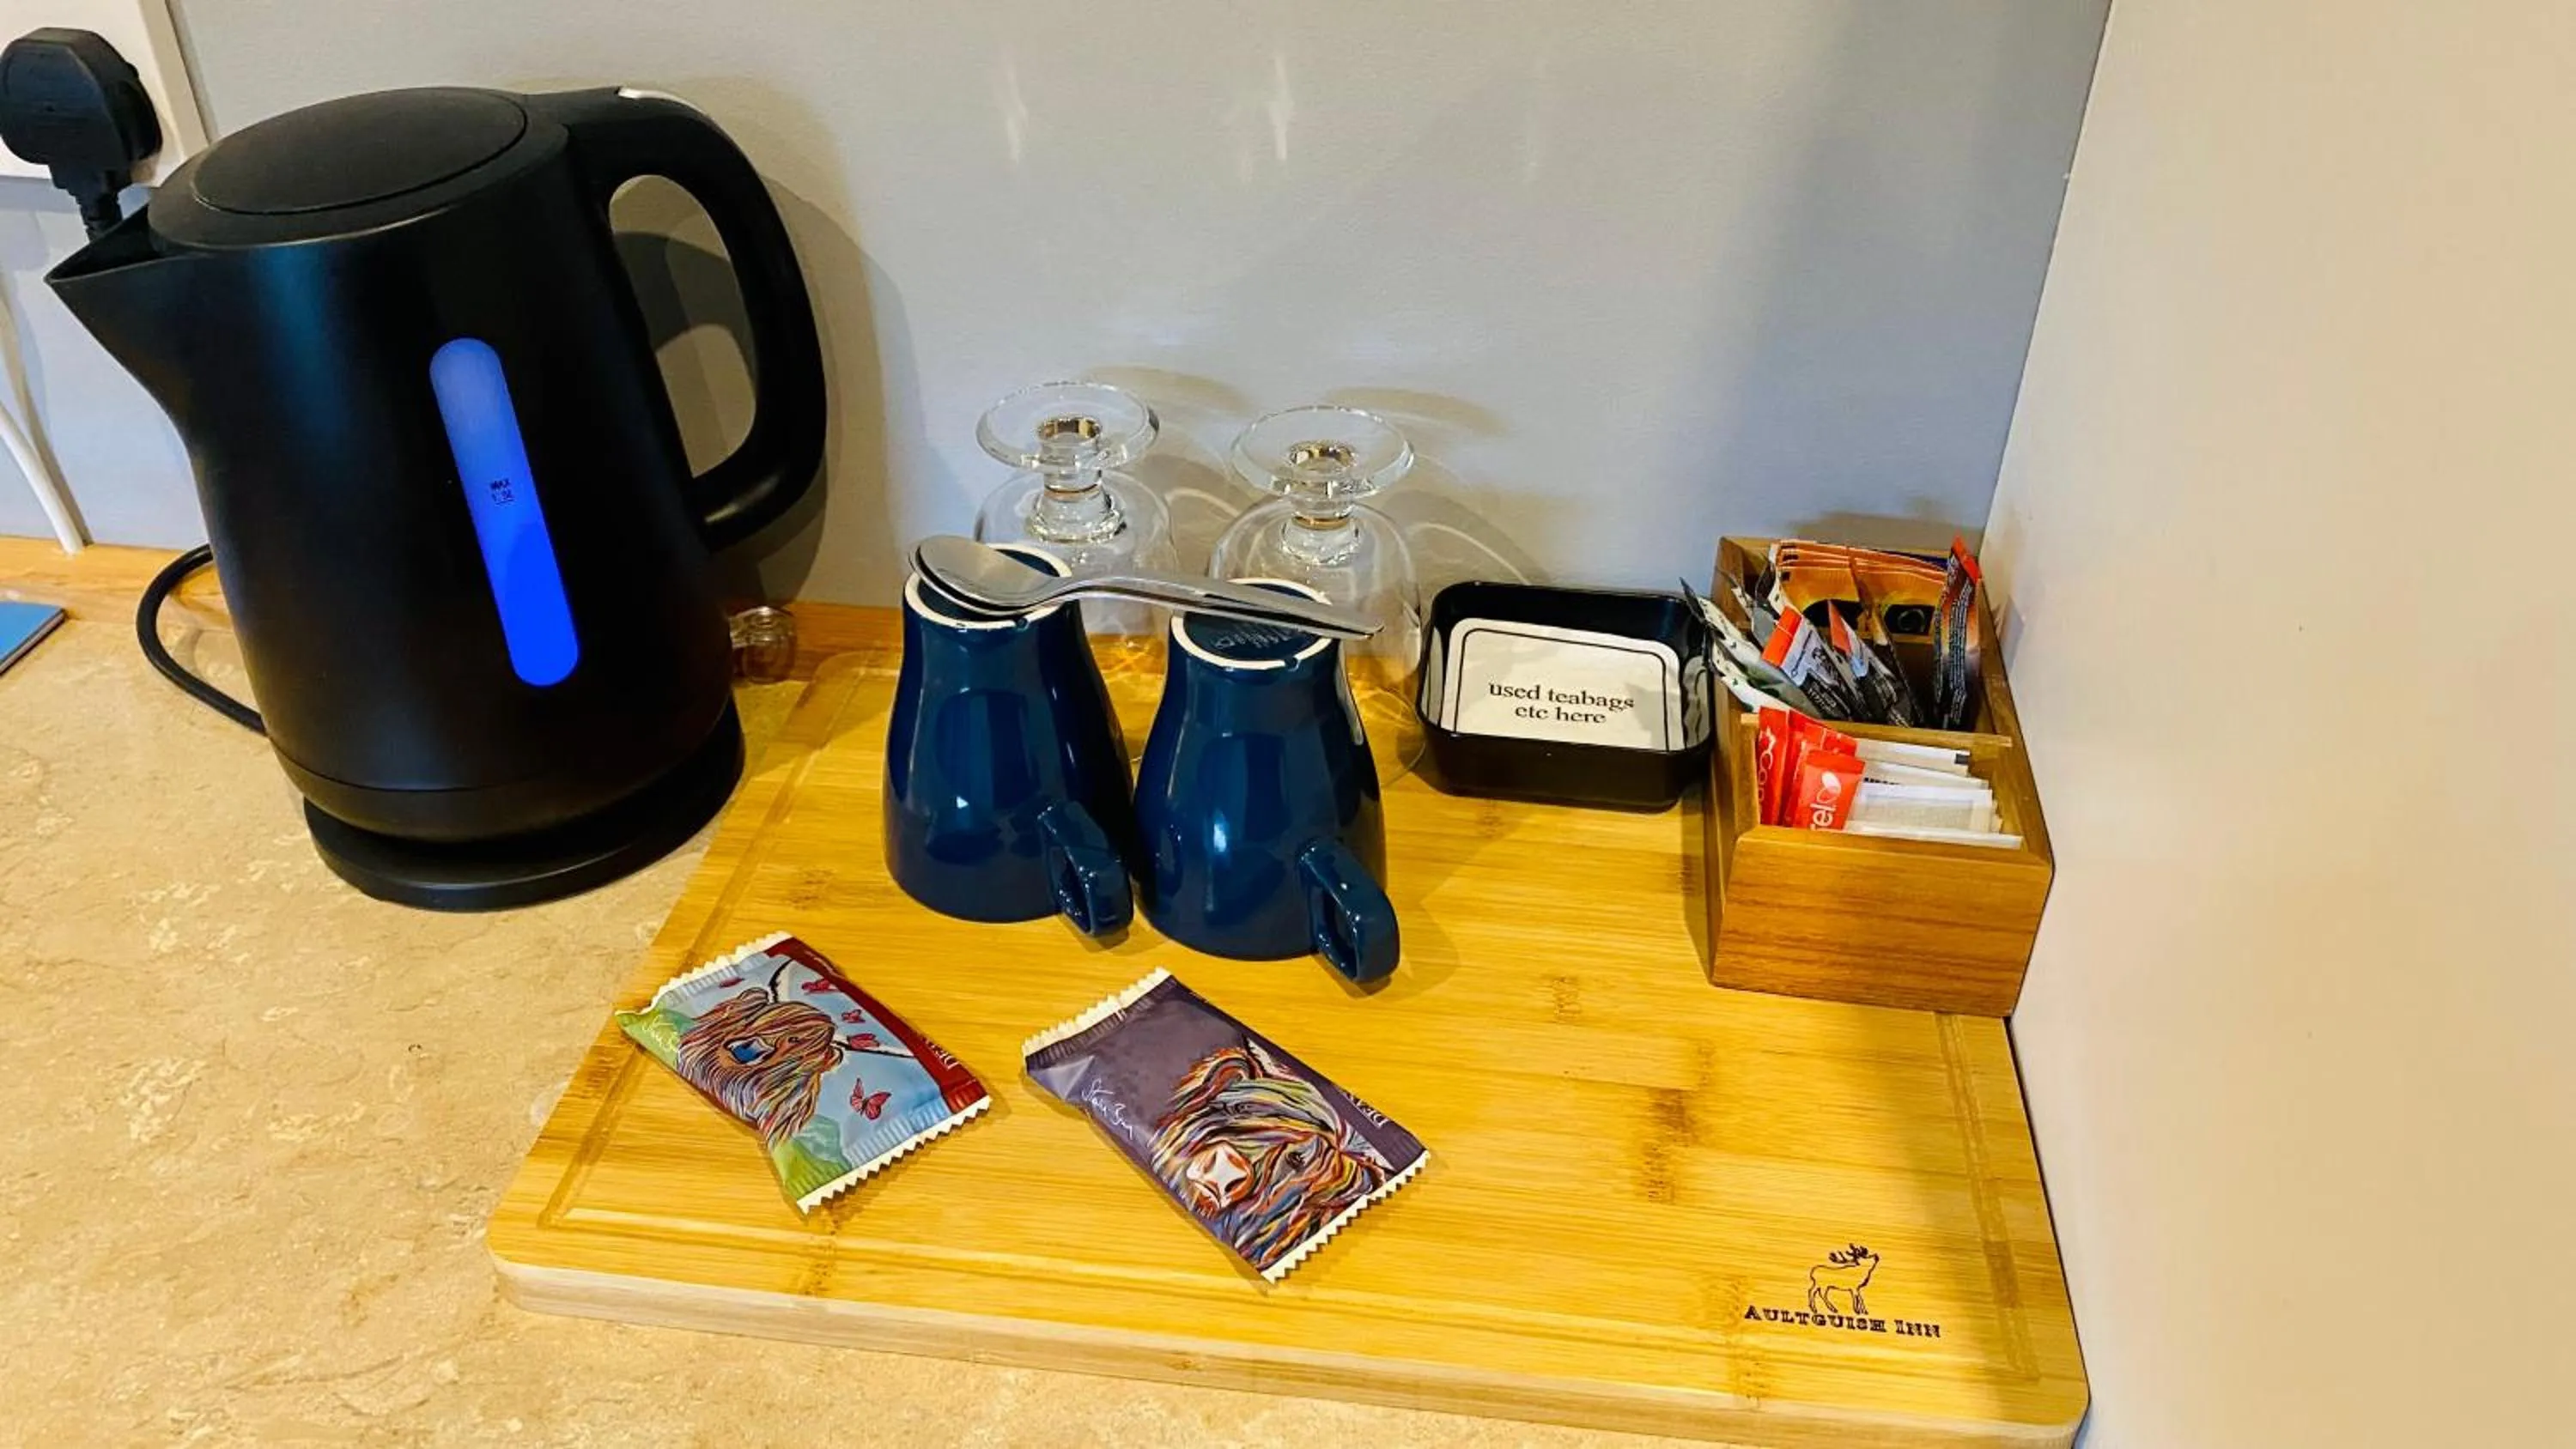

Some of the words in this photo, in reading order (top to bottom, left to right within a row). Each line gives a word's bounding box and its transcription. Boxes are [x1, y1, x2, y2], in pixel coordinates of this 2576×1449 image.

[1489, 682, 1540, 700] used
[1547, 689, 1635, 712] teabags
[1515, 705, 1549, 719] etc
[1556, 707, 1607, 724] here
